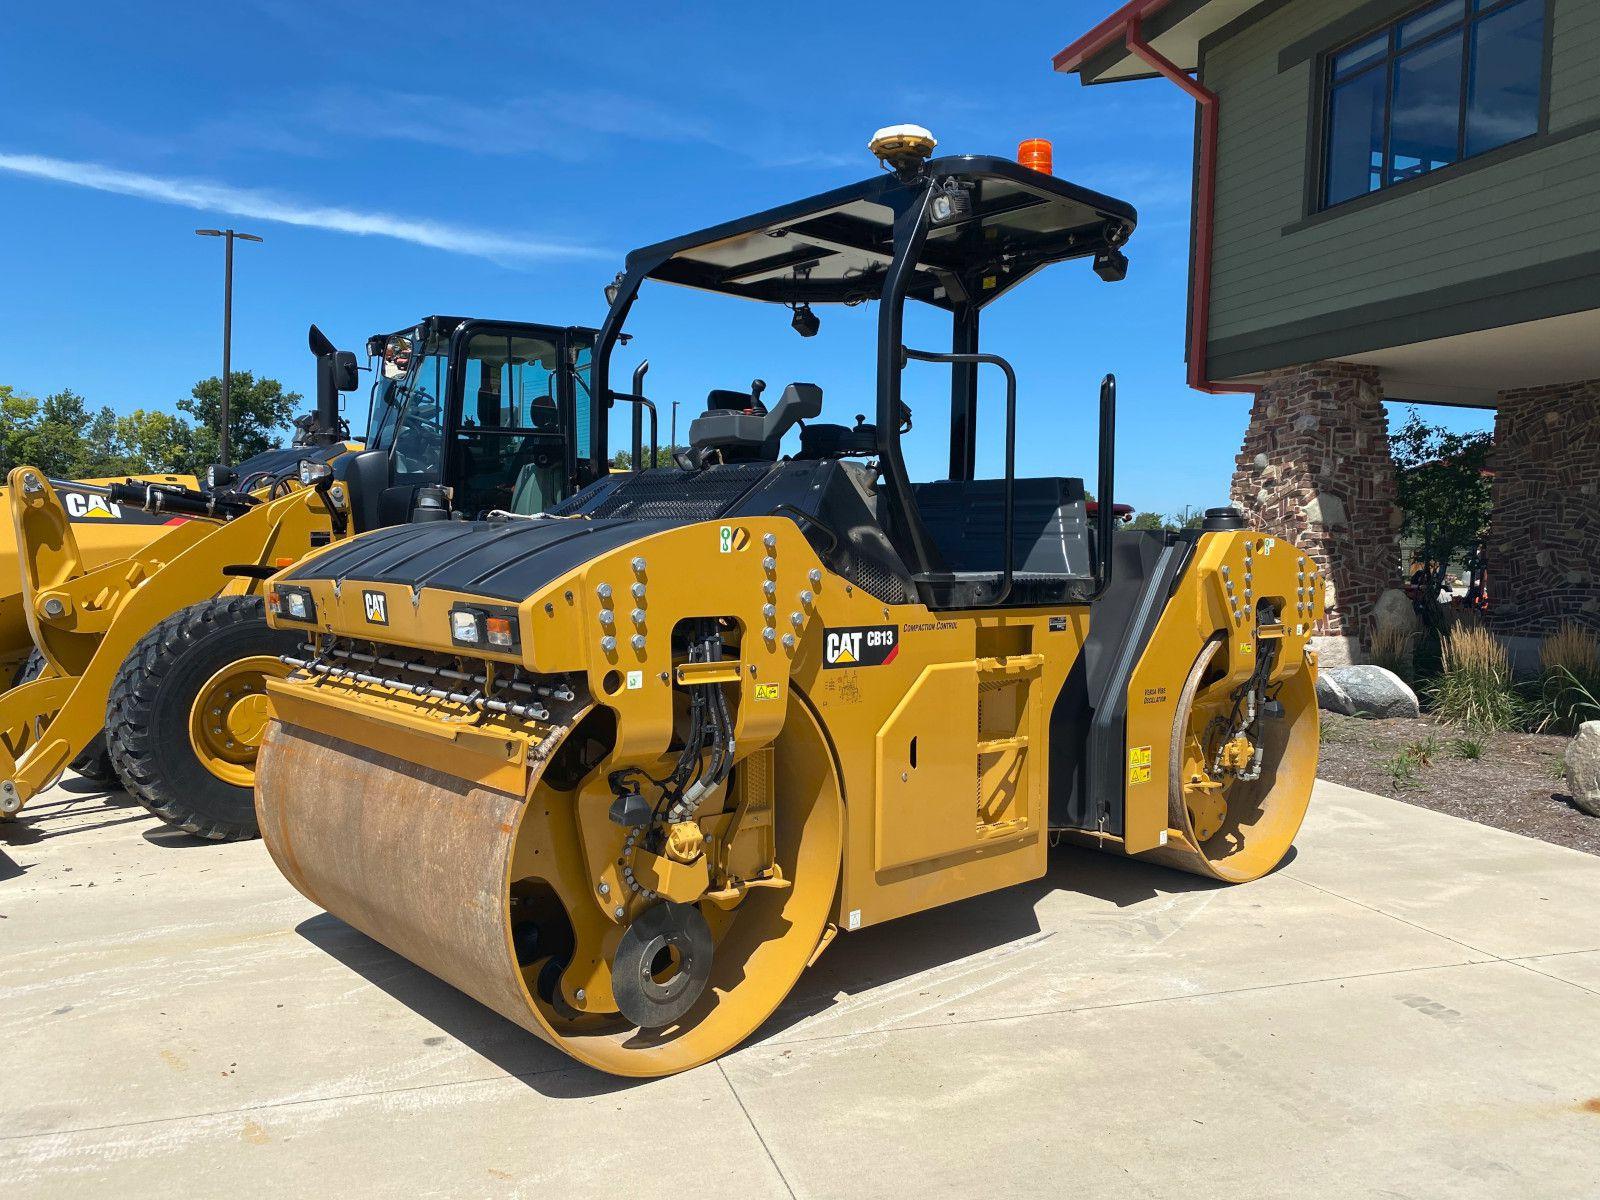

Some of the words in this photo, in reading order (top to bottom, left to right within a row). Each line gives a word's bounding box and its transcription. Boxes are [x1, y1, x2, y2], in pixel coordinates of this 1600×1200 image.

[365, 593, 386, 622] CAT
[827, 632, 863, 663] CAT
[867, 630, 894, 647] CB13
